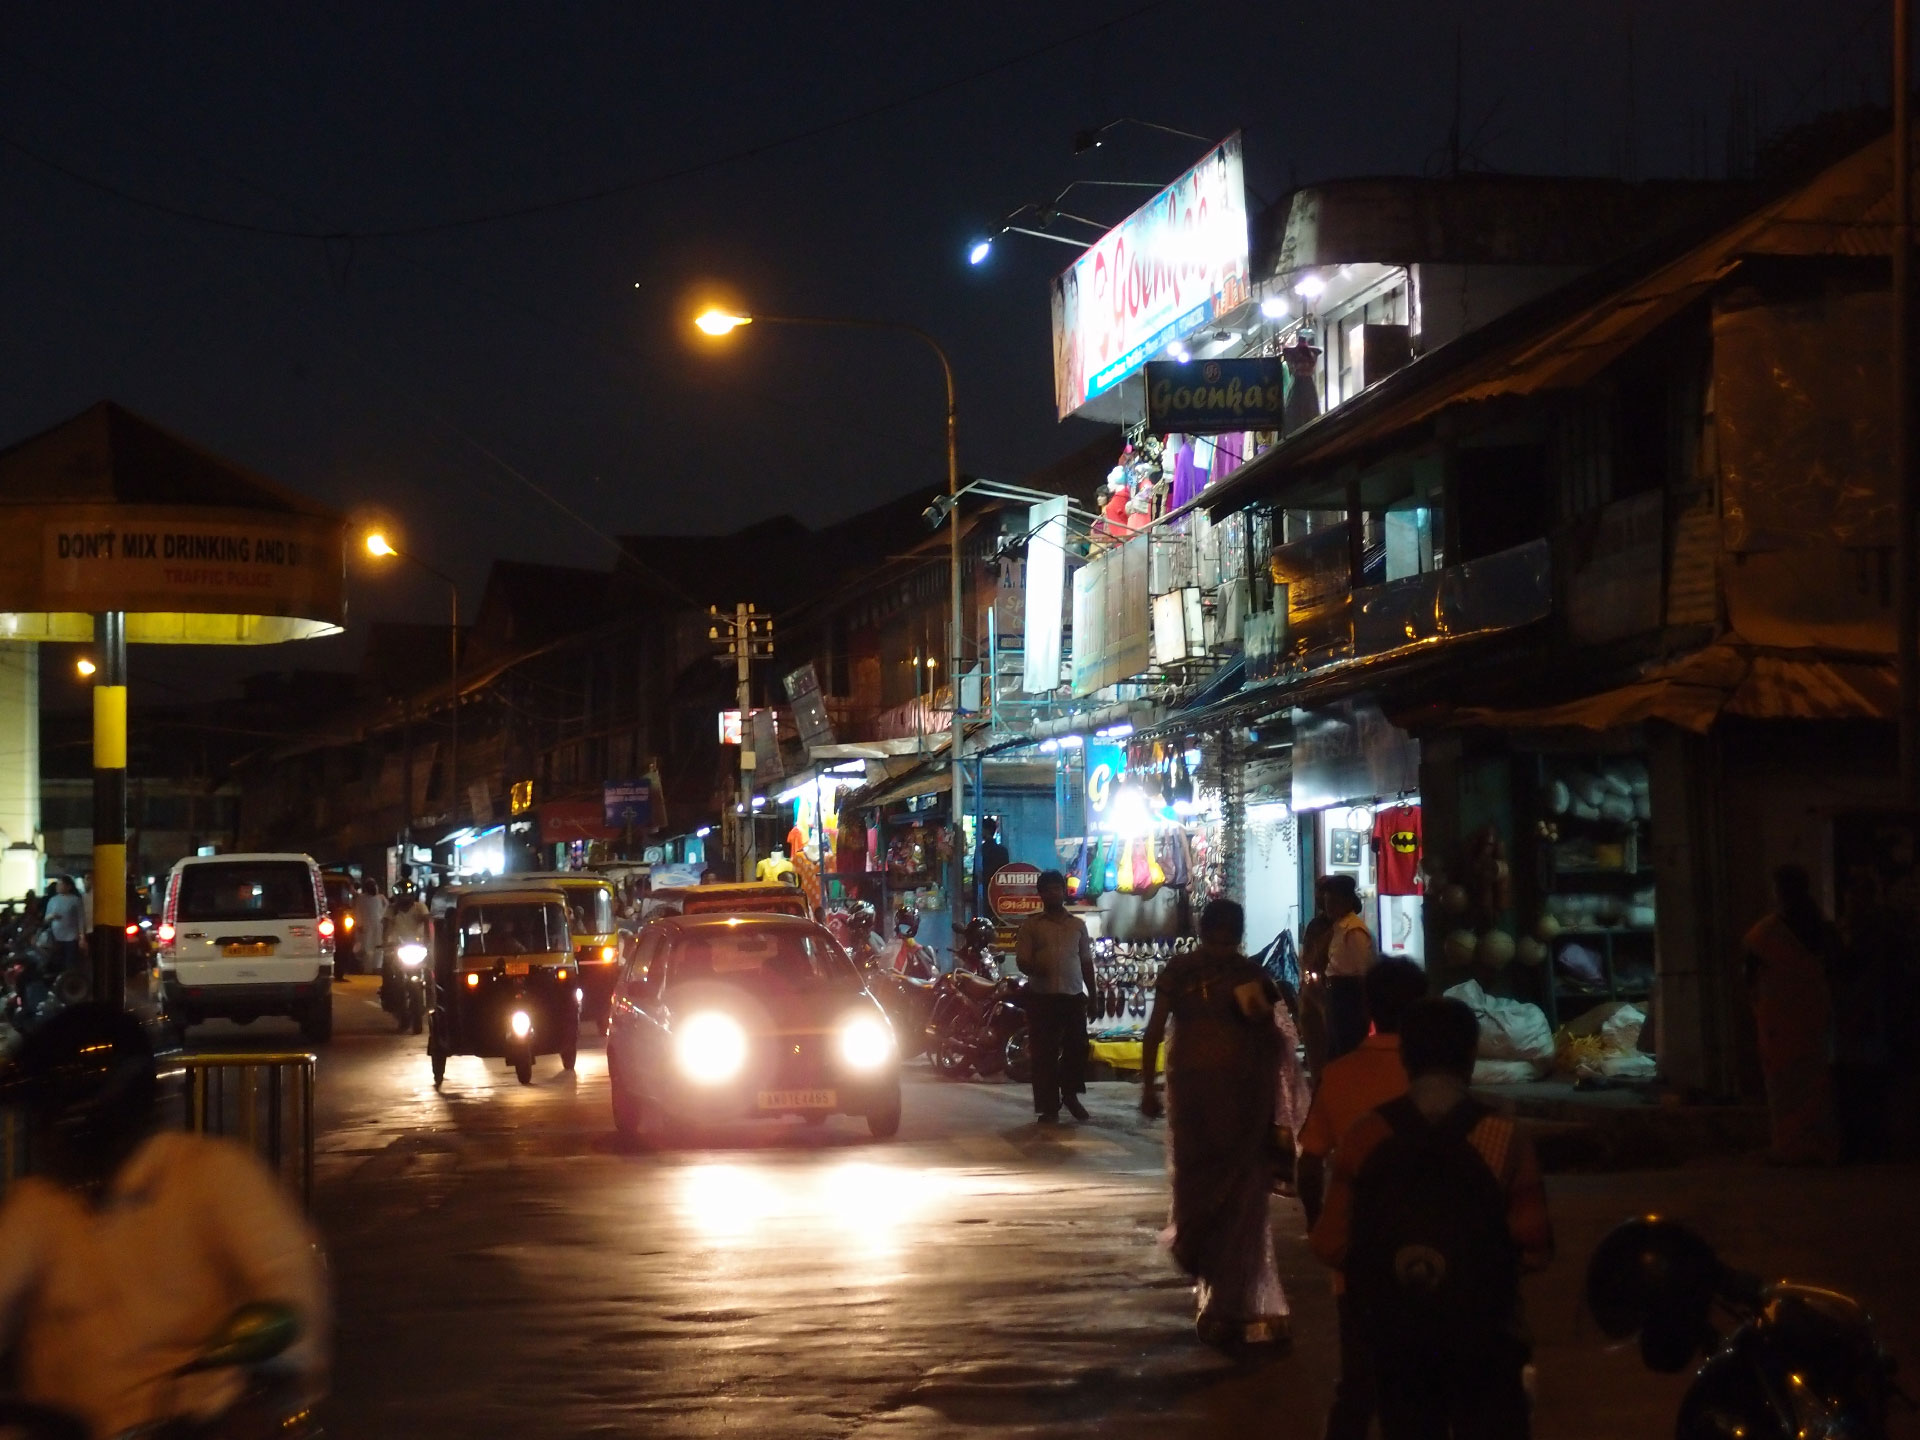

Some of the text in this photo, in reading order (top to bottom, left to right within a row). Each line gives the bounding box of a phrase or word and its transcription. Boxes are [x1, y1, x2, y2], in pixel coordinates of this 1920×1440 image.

[1151, 376, 1279, 418] Goenka's
[58, 531, 116, 560] DON'T
[122, 533, 157, 559] MIX
[163, 533, 250, 562] DRINKING
[254, 538, 285, 564] AND
[163, 568, 223, 584] TRAFFIC
